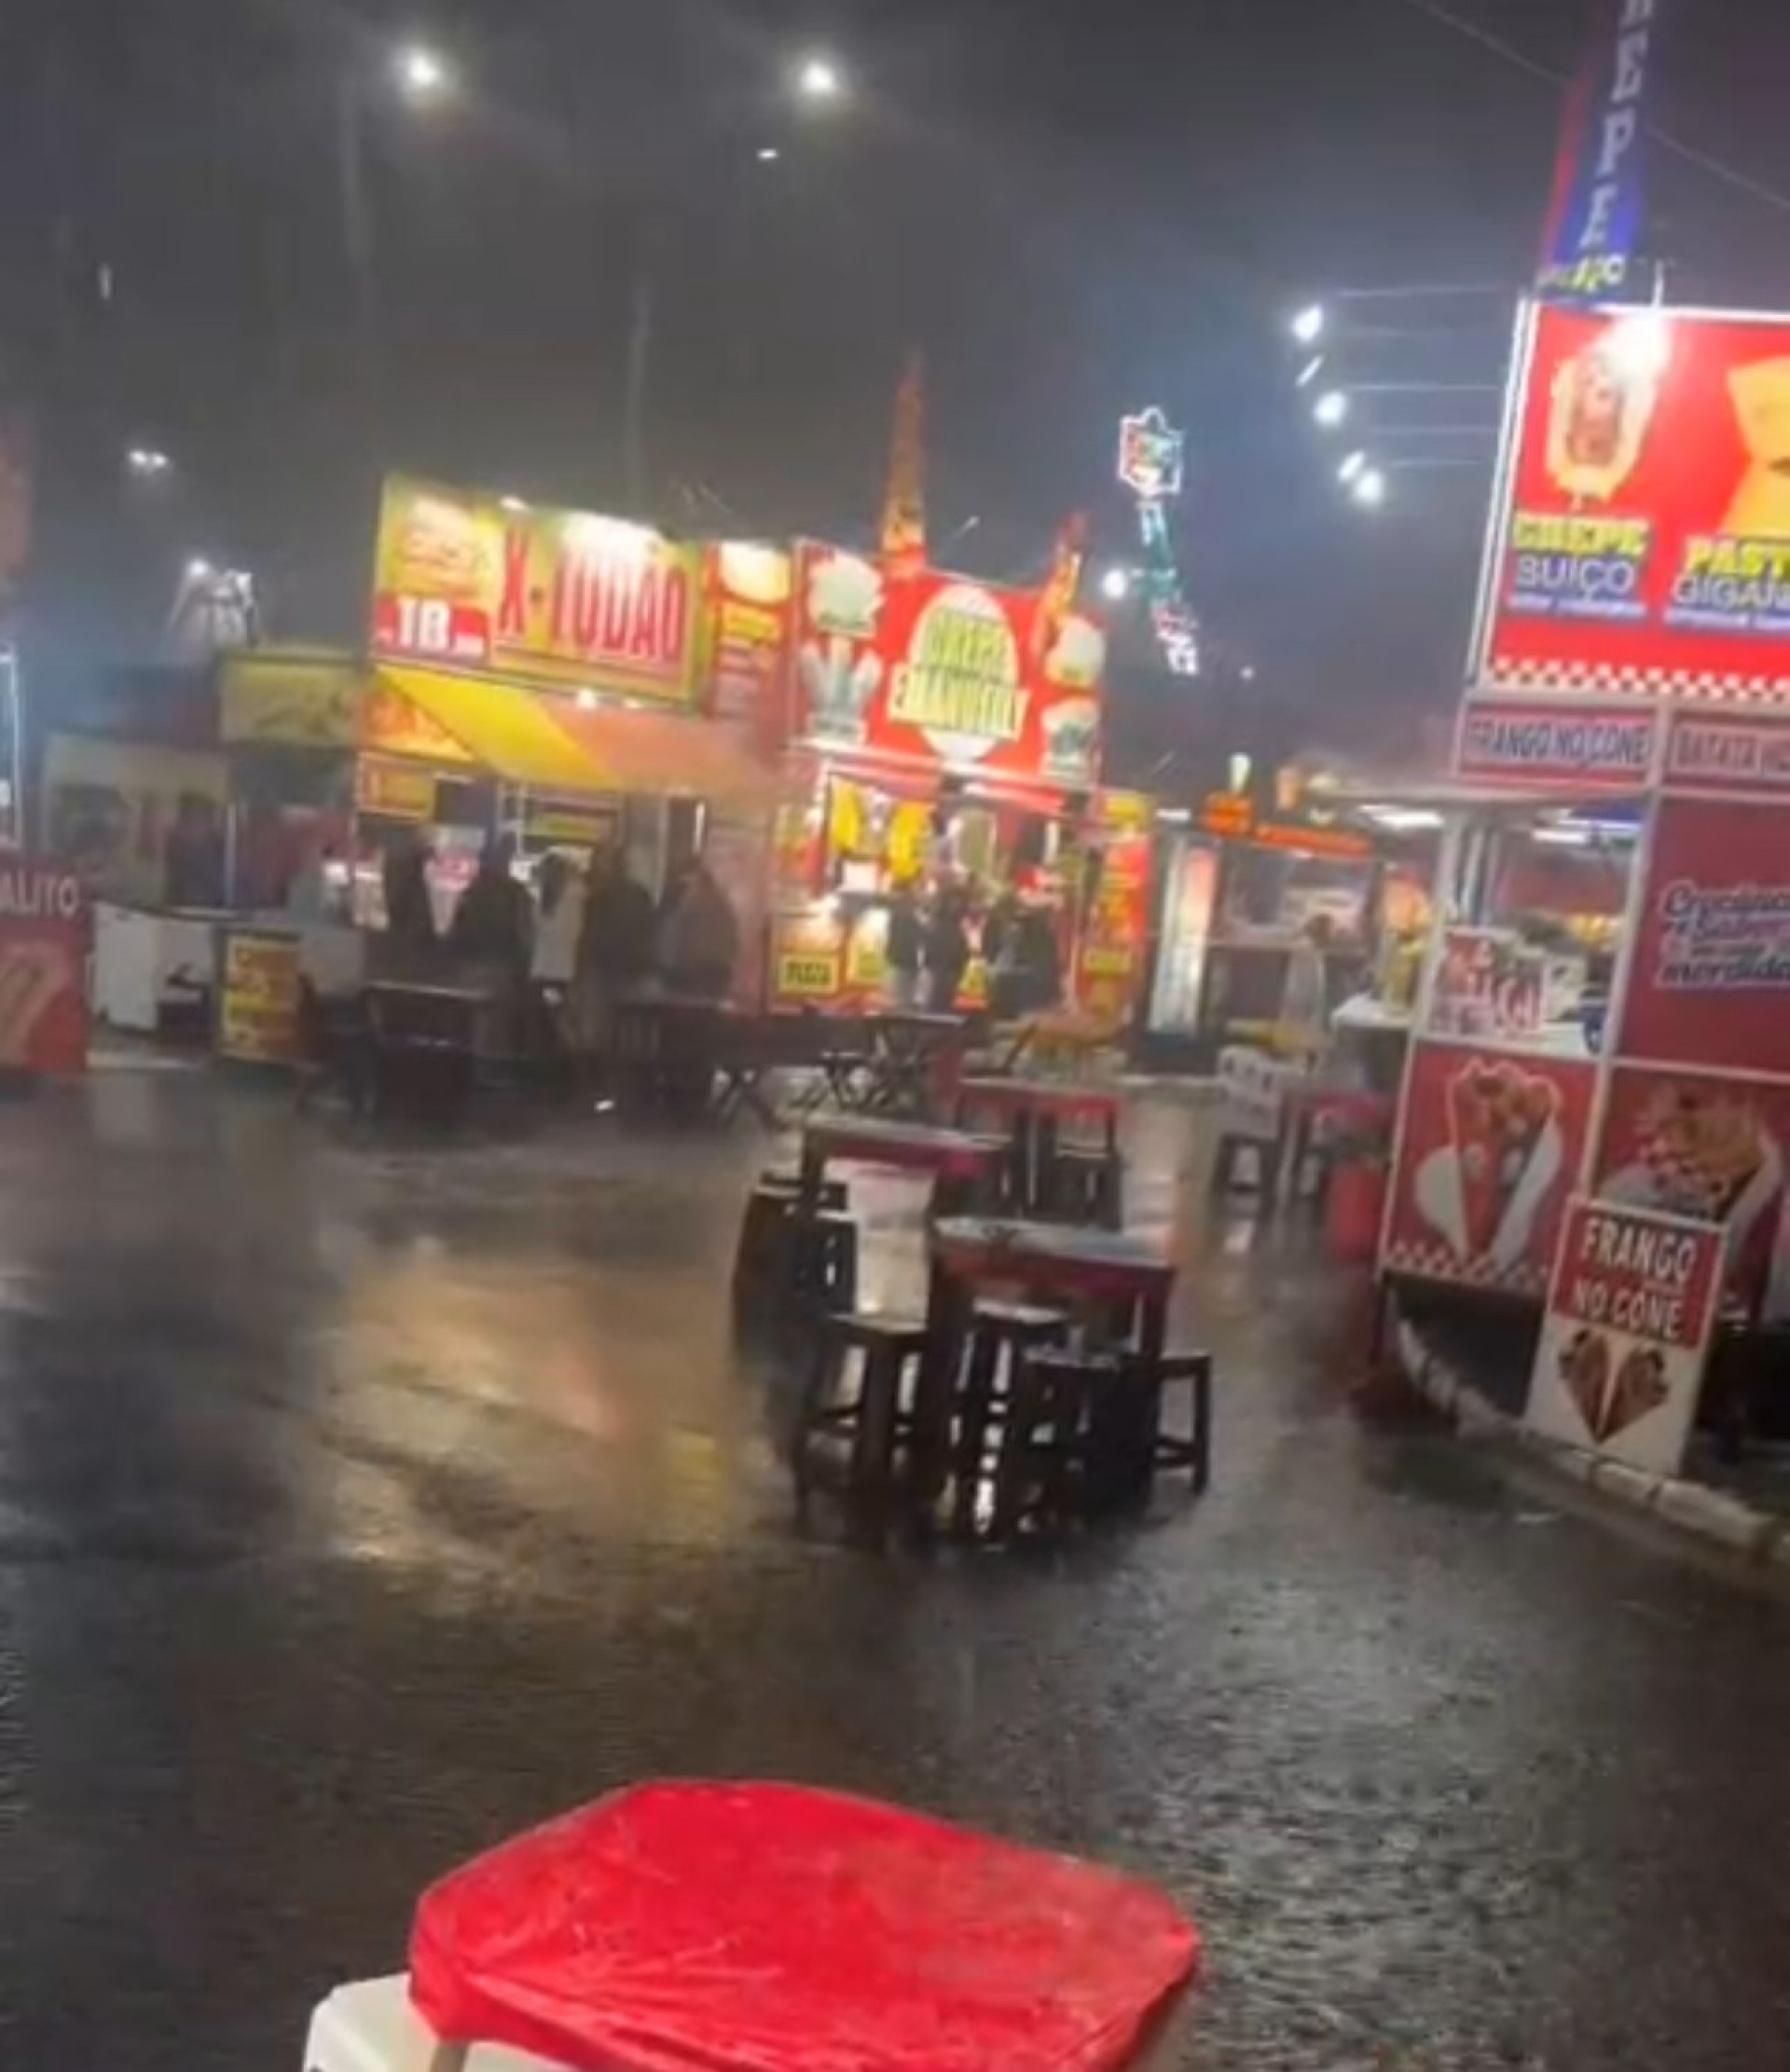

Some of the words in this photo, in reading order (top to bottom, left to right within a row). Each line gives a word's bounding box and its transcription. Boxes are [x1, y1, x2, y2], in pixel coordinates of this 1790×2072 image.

[1582, 1216, 1698, 1283] FRANGO
[1573, 1278, 1609, 1316] NO
[1613, 1286, 1683, 1337] CONE
